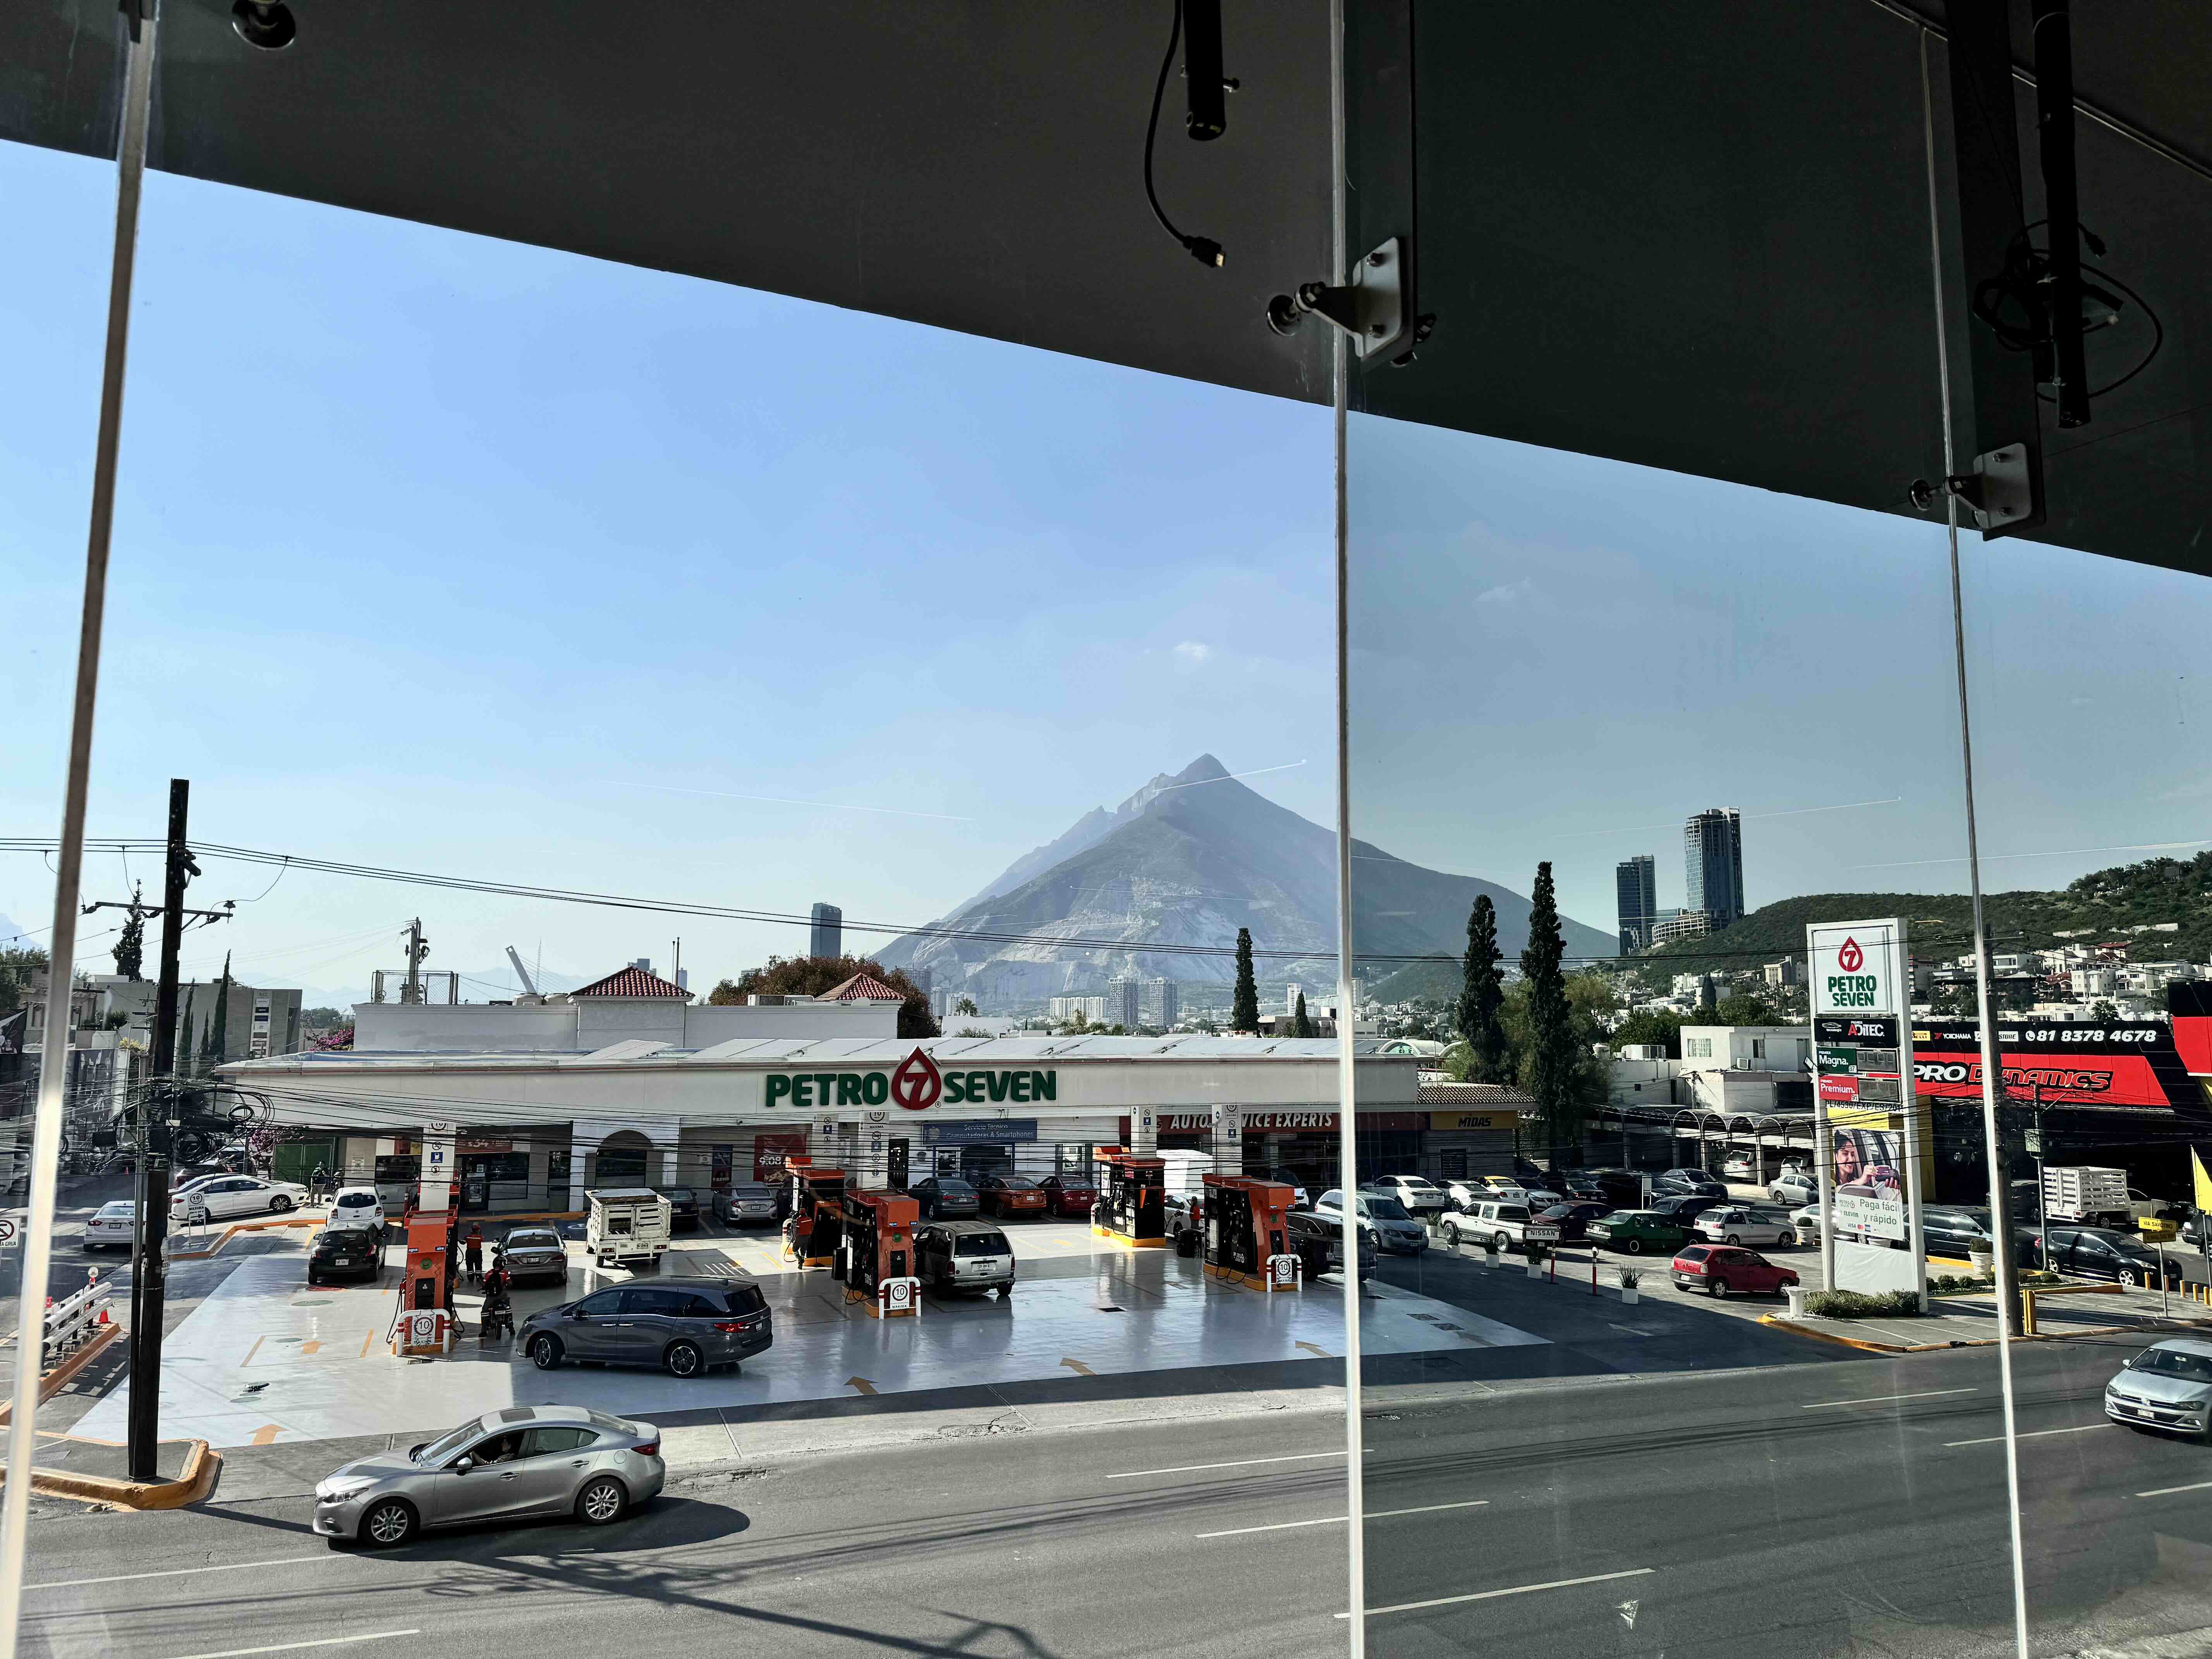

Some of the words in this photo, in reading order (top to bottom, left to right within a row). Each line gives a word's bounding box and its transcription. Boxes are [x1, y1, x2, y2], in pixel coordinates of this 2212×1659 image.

[1828, 975, 1877, 992] PETRO
[1832, 992, 1874, 1006] SEVEN
[2037, 1030, 2056, 1041] 81
[2061, 1030, 2104, 1041] 8378
[2109, 1030, 2157, 1042] 4678
[1914, 1065, 1966, 1081] PRO
[1968, 1065, 2110, 1088] DNAMICS
[766, 1072, 888, 1107] PETRO
[944, 1071, 1056, 1103] SEVEN
[1170, 1114, 1208, 1129] AUTO
[1275, 1112, 1332, 1127] EXPERTS
[1860, 1199, 1880, 1211] Paga
[1863, 1214, 1868, 1222] y
[1870, 1214, 1896, 1225] rápido
[419, 1321, 430, 1329] 10
